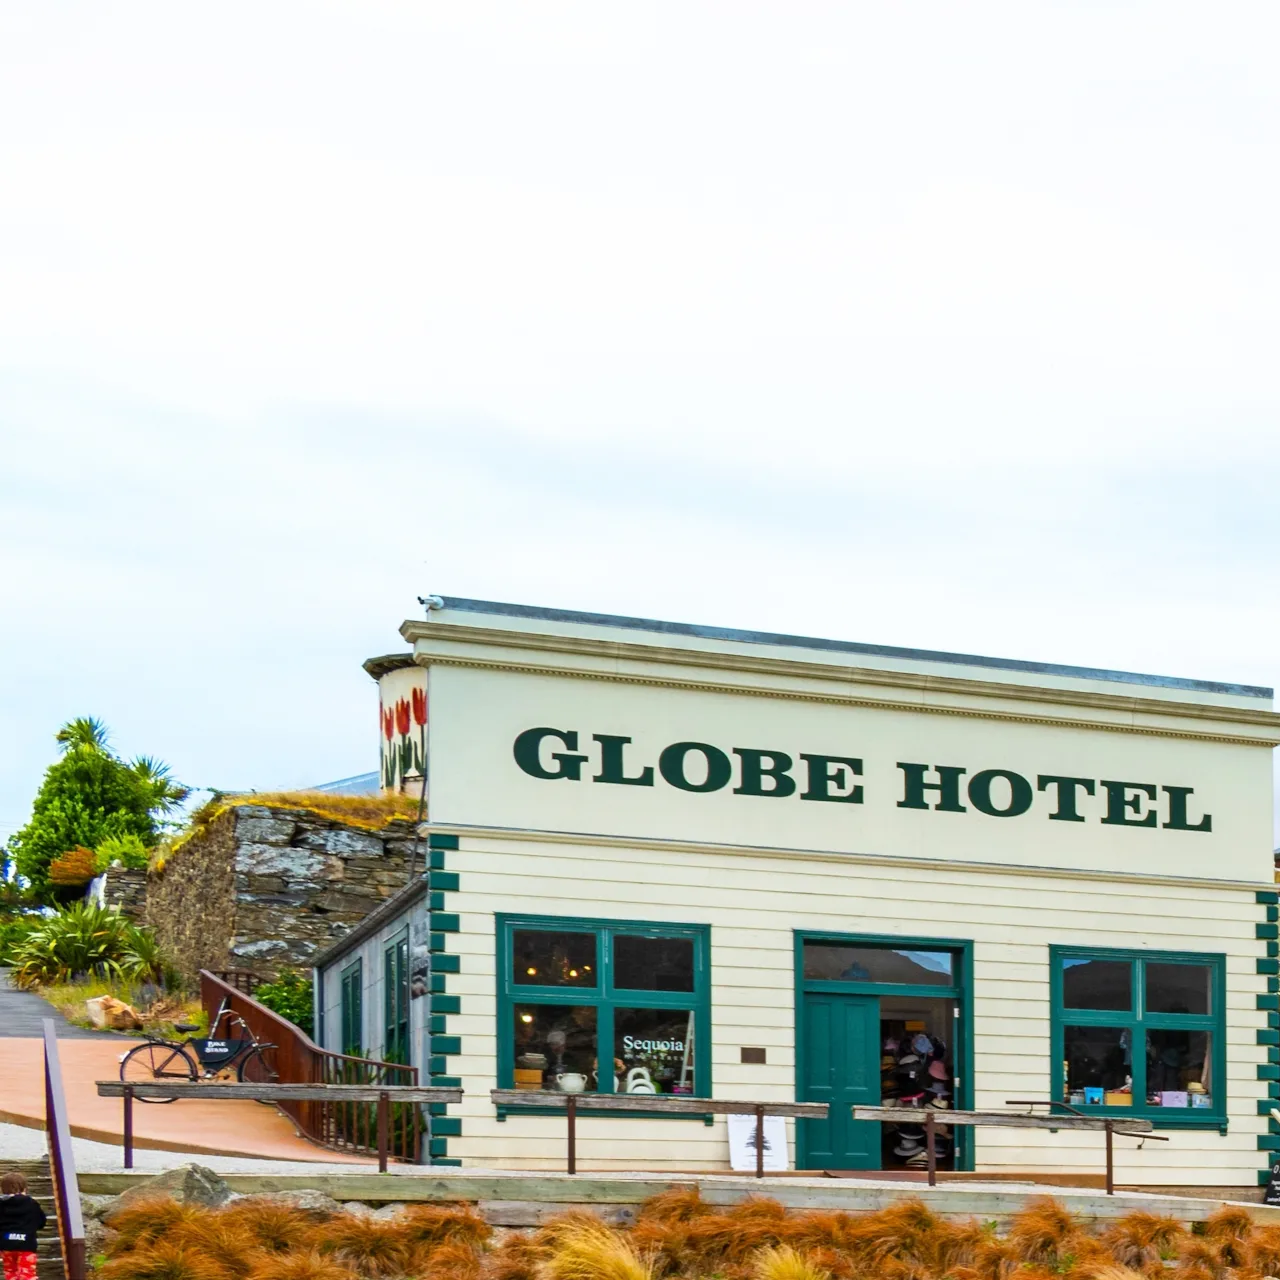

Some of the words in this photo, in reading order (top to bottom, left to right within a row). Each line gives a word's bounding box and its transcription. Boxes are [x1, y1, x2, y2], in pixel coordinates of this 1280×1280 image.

[513, 727, 864, 804] GLOBE
[896, 761, 1212, 833] HOTEL
[623, 1035, 684, 1054] Sequoia
